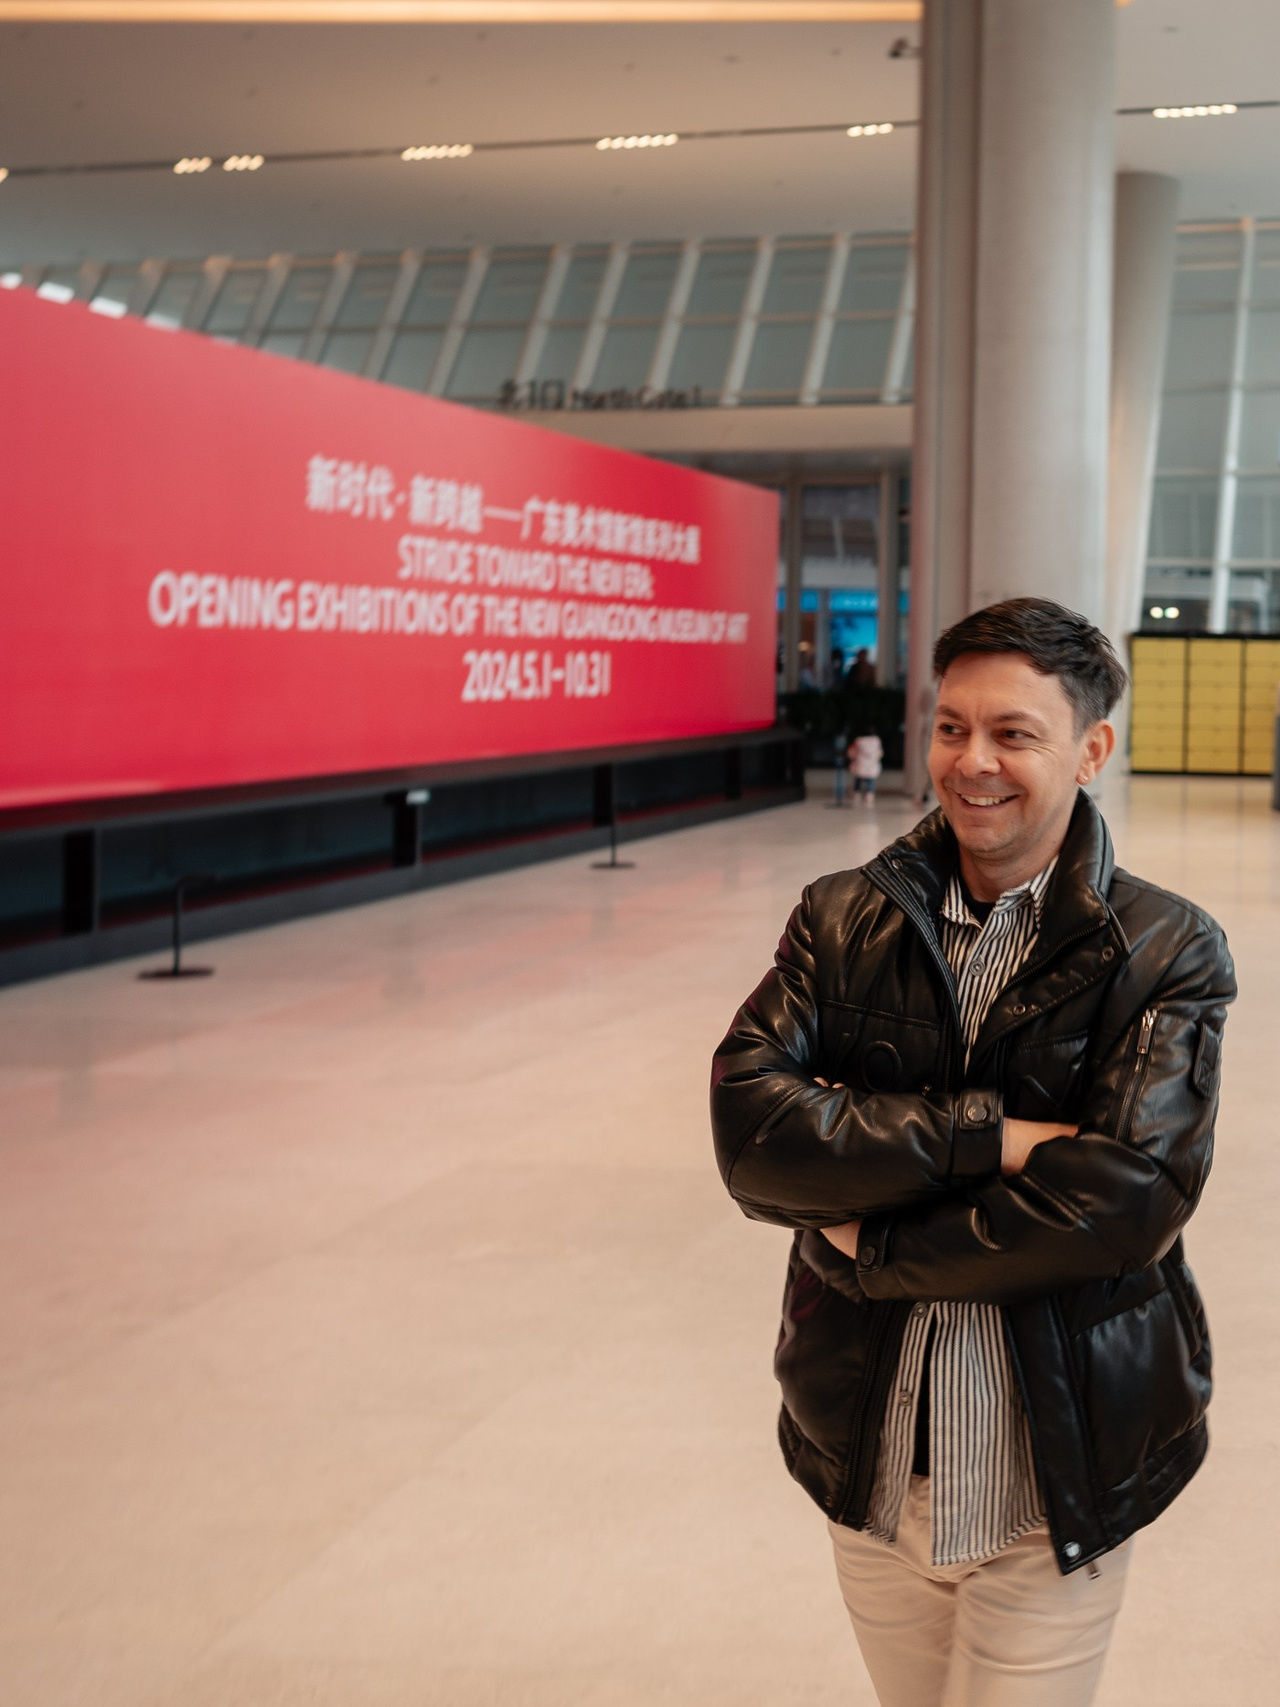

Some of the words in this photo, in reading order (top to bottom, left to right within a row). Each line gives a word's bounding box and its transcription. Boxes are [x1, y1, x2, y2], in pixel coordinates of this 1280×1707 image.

[398, 534, 474, 585] STRIDE
[476, 543, 556, 592] TOWARD
[557, 553, 588, 595] THE
[589, 558, 621, 597] NEW
[149, 570, 294, 631] OPENING
[297, 581, 448, 637] EXHIBITIONS
[449, 592, 480, 637] OF
[481, 594, 519, 638] THE
[520, 597, 560, 639] NEW
[561, 599, 658, 642] GUANGDONG
